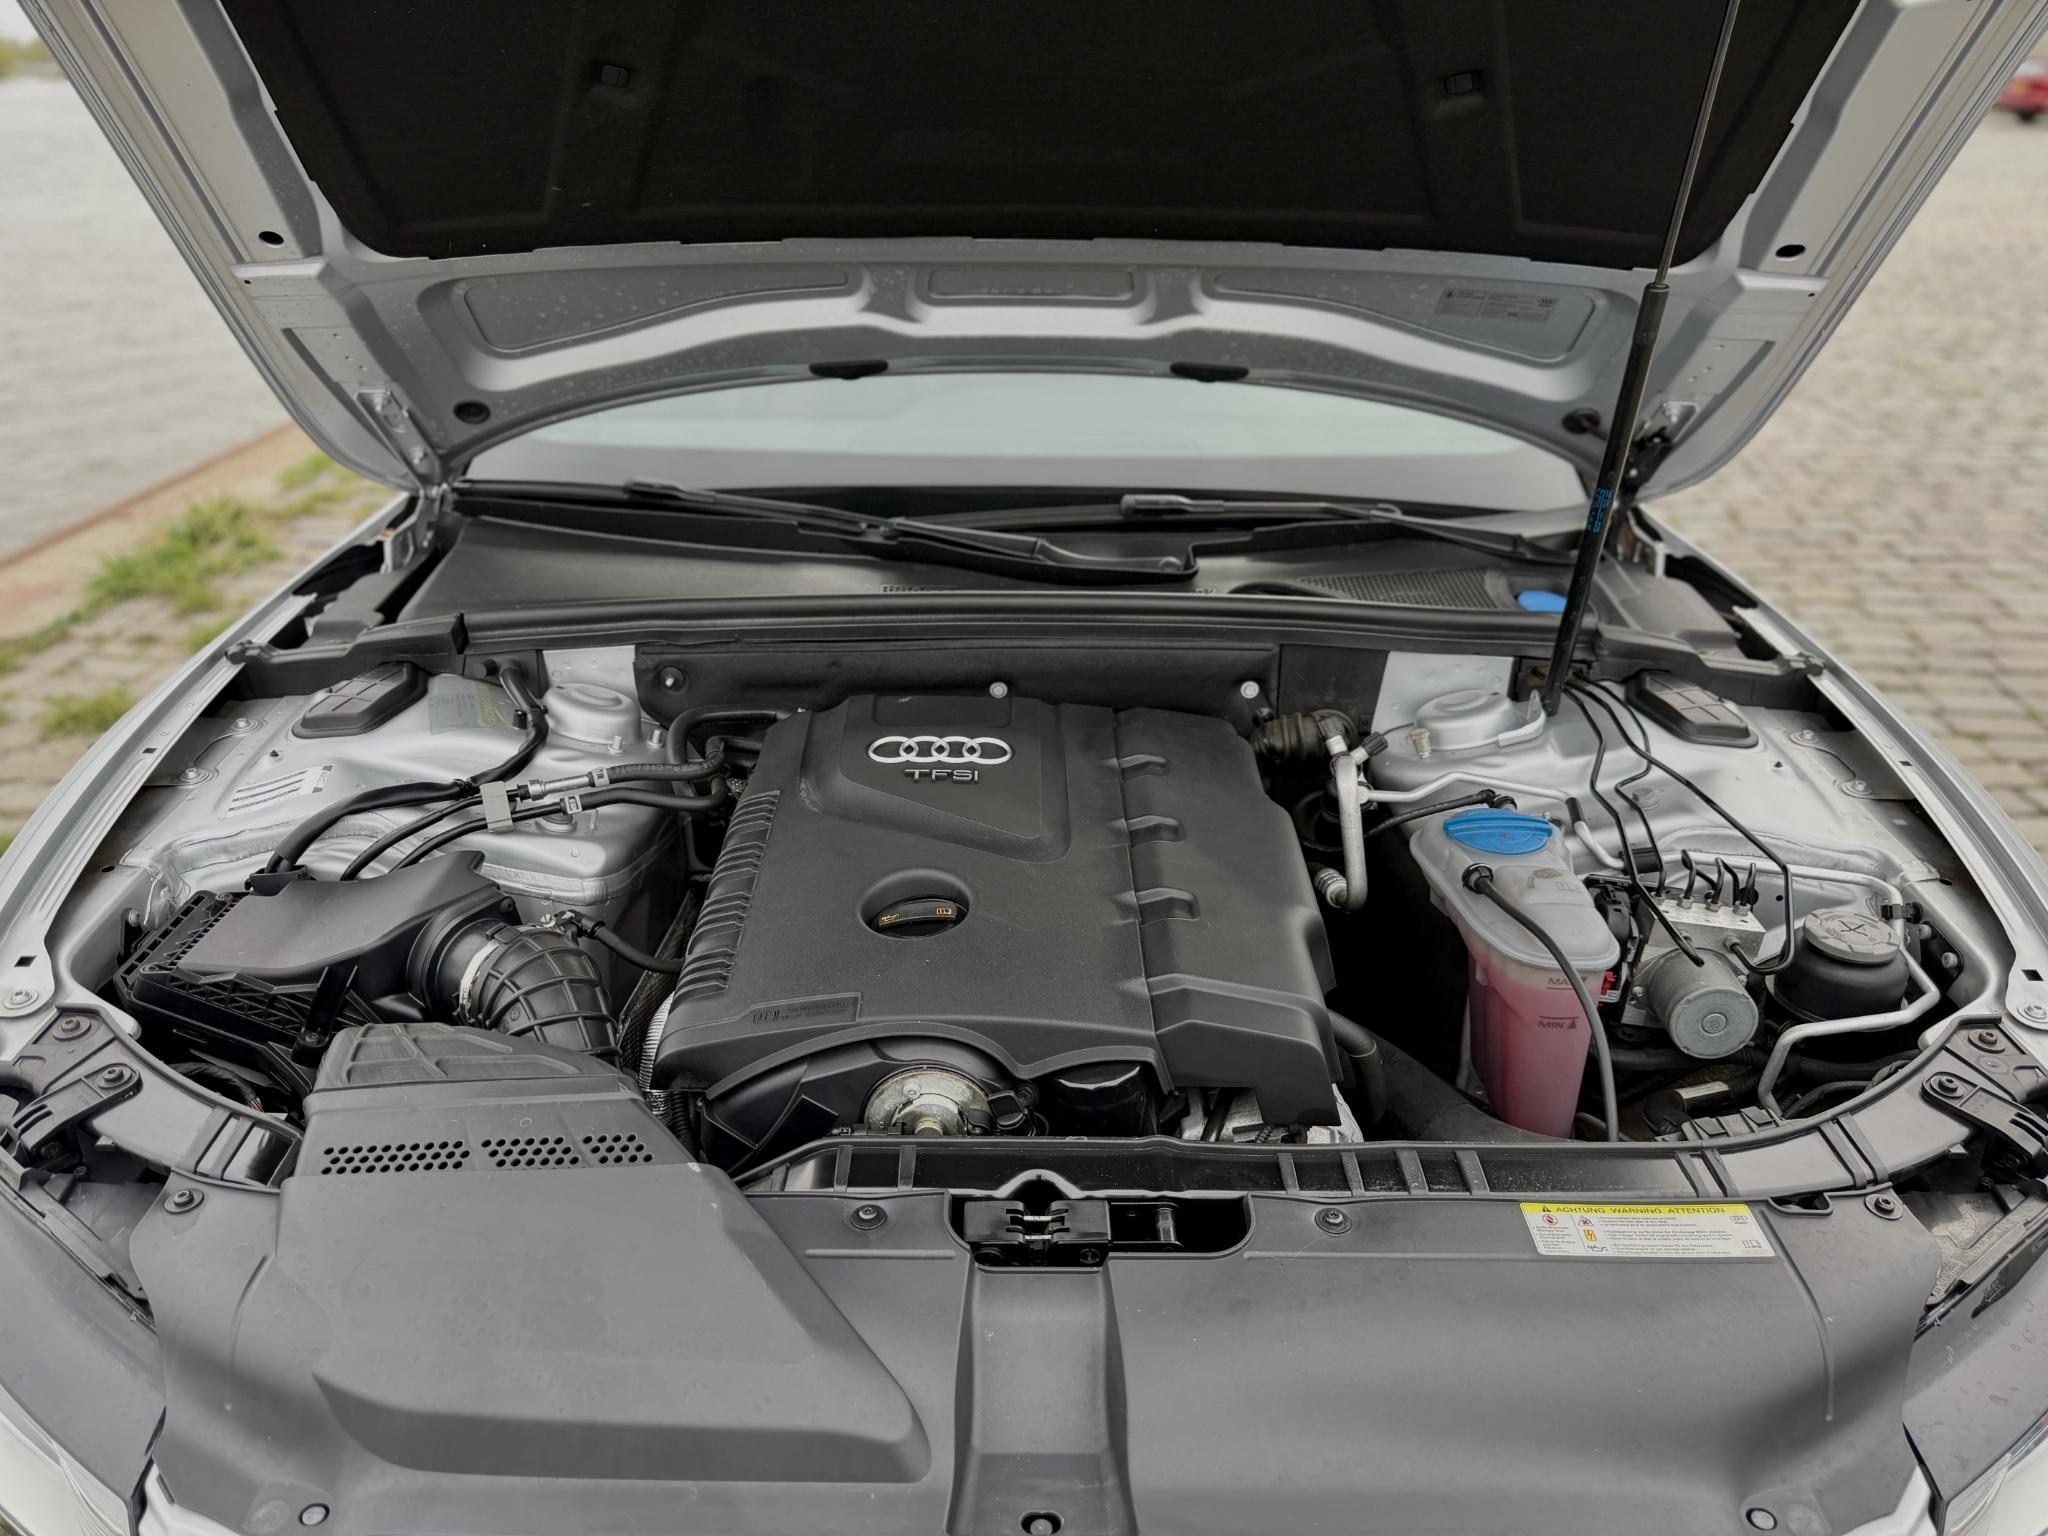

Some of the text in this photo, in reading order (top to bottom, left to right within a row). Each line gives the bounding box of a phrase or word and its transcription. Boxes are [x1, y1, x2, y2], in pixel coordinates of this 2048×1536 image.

[904, 769, 979, 783] TFSI
[1547, 977, 1570, 986] MA
[1538, 1020, 1565, 1030] MIN
[1555, 1206, 1725, 1215] ACHTUNG WARNING ATTENTION
